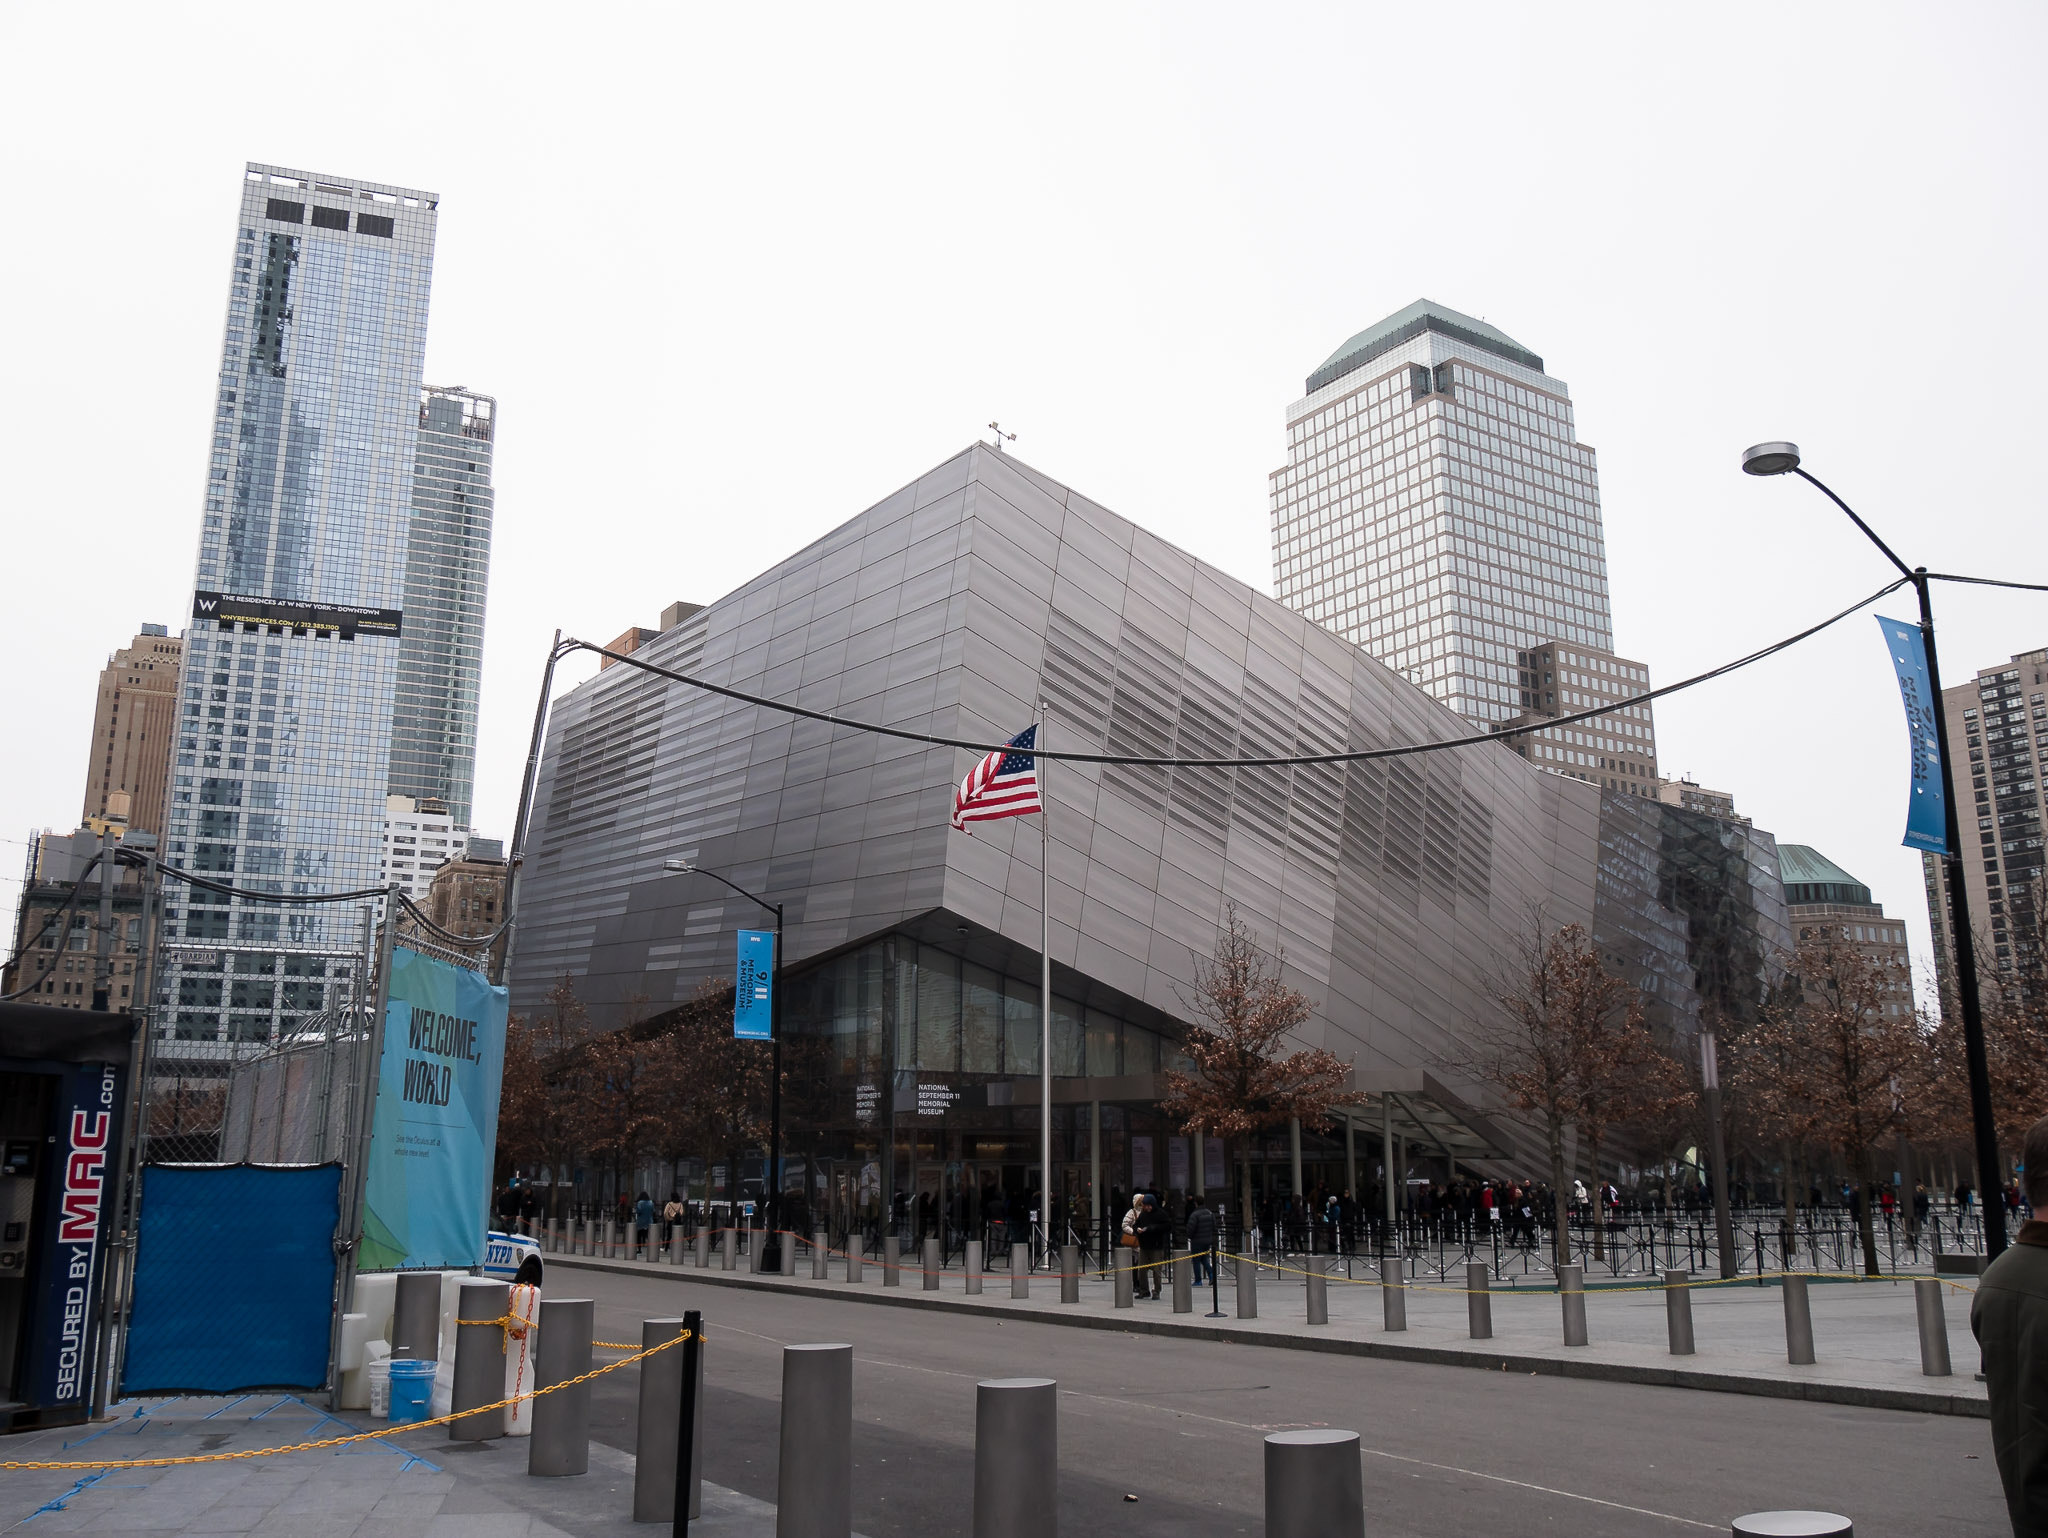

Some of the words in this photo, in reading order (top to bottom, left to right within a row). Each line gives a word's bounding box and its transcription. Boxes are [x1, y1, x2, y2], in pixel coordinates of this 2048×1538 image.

[199, 599, 217, 612] W
[222, 594, 236, 602] THE
[236, 595, 277, 606] RESIDENCES
[219, 613, 294, 627] WNYRESIDENCES.COM
[1907, 676, 1928, 782] MEMORIAL
[179, 952, 216, 960] GUARDIAN
[739, 968, 747, 1009] MUSEUM
[746, 960, 754, 1010] MEMORIAL
[754, 971, 768, 999] 9/11
[409, 1006, 482, 1065] WELCOME,
[402, 1058, 452, 1107] WORLD
[69, 1246, 90, 1278] BY
[486, 1244, 513, 1265] NYPD
[56, 1286, 84, 1399] SECURED
